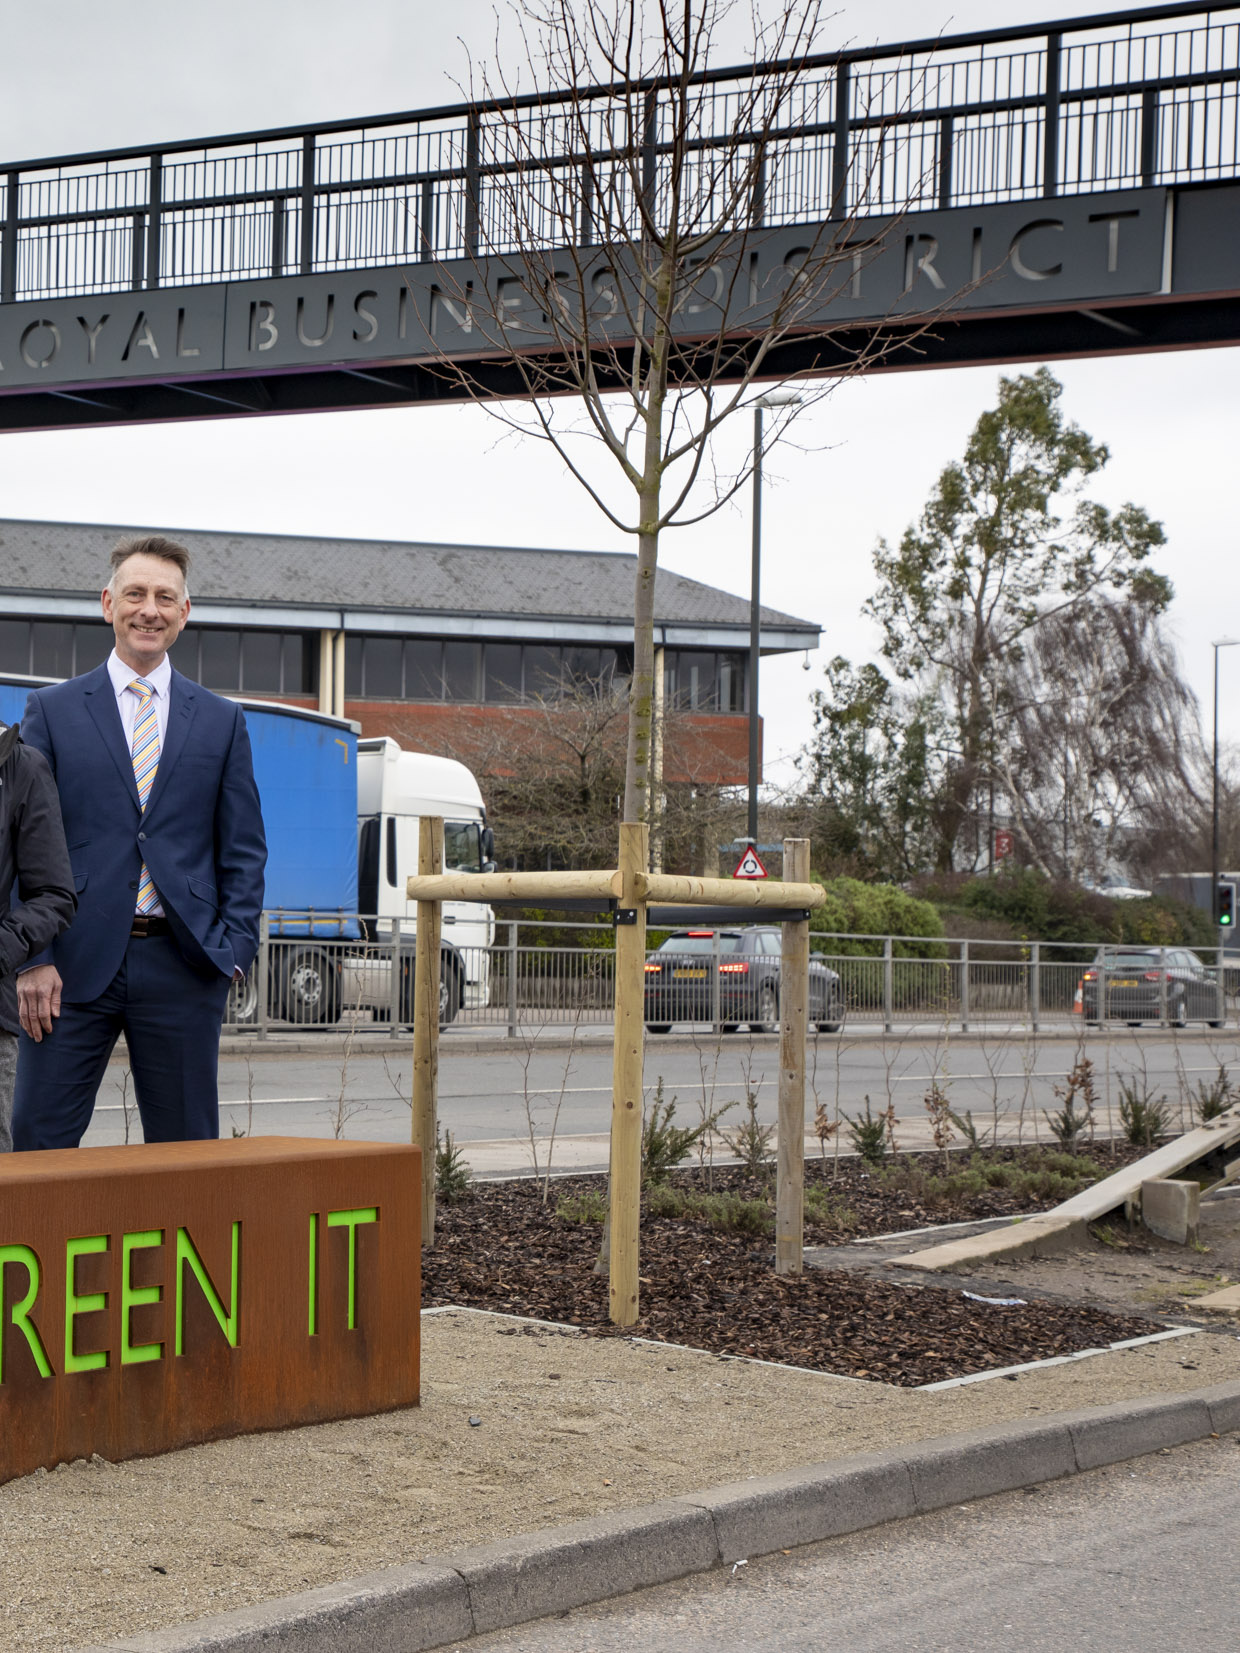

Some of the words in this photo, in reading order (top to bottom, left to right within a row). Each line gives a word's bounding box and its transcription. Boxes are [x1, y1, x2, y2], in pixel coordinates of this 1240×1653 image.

[248, 266, 620, 352] BUSINESS
[679, 208, 1140, 314] DISTRICT
[308, 1205, 381, 1336] IT
